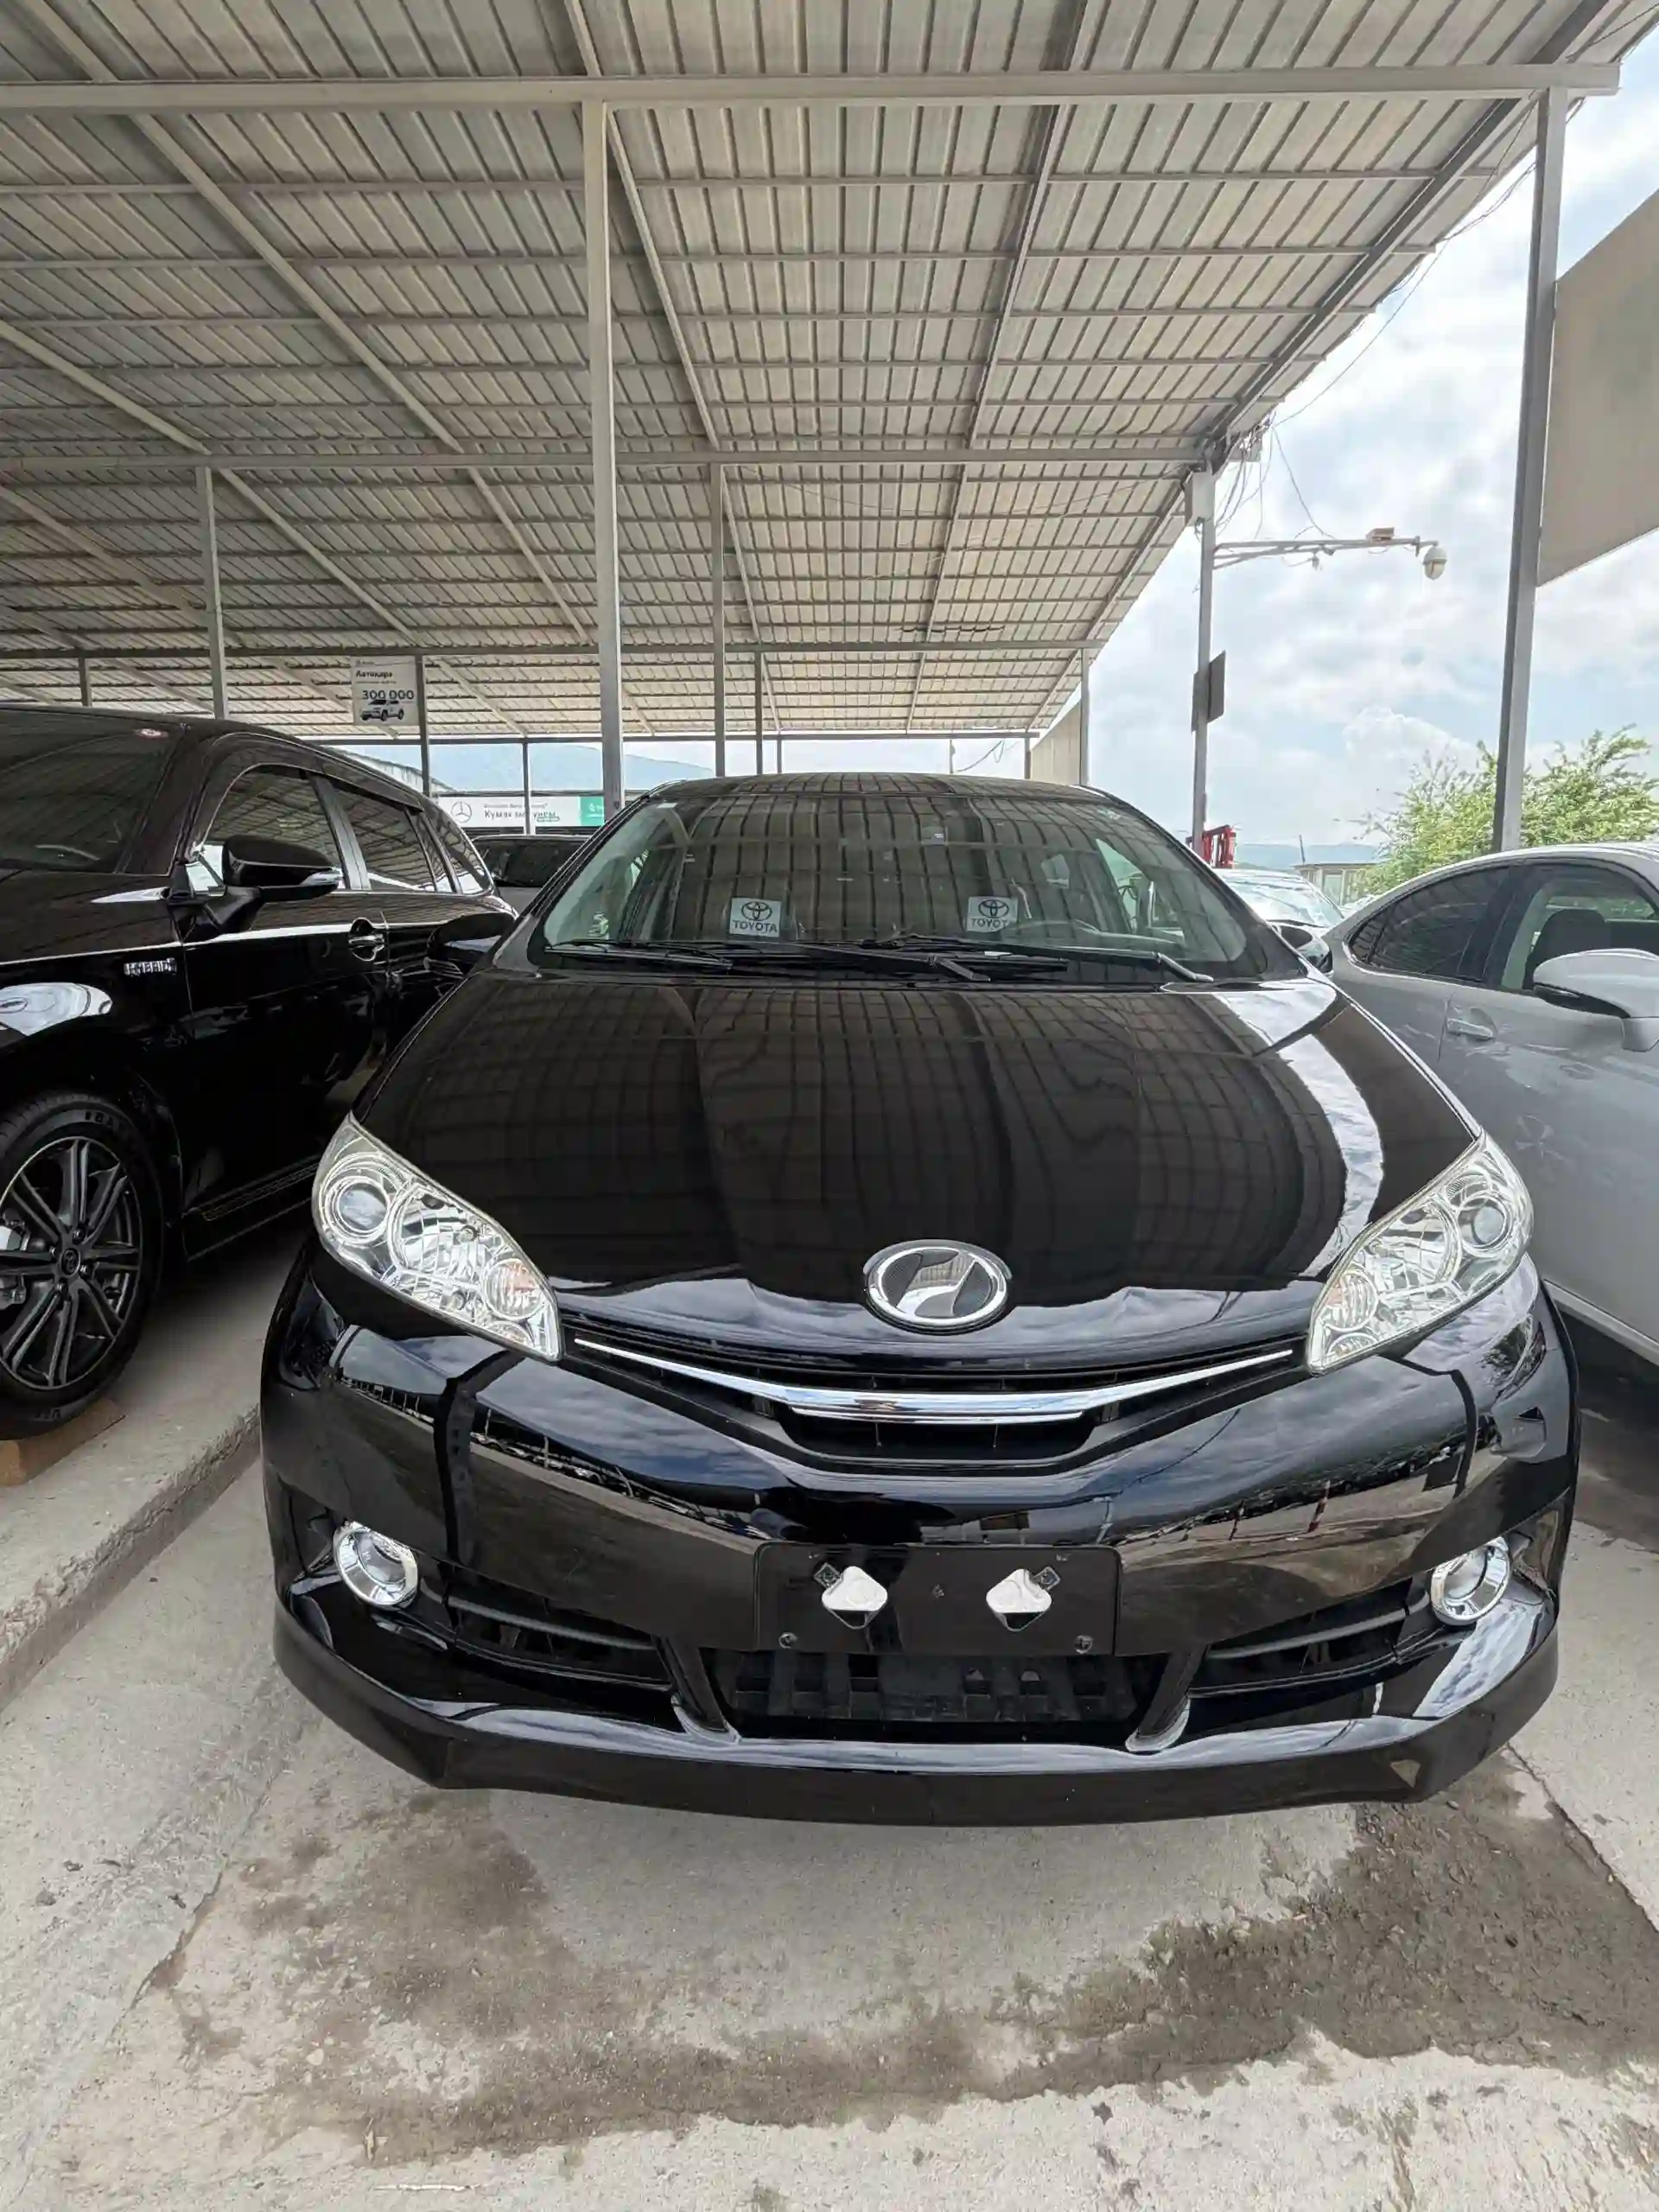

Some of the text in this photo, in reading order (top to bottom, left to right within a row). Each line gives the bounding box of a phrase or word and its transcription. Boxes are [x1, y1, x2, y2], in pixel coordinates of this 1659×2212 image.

[362, 690, 415, 700] 300 000
[732, 919, 778, 933] TOYOTA
